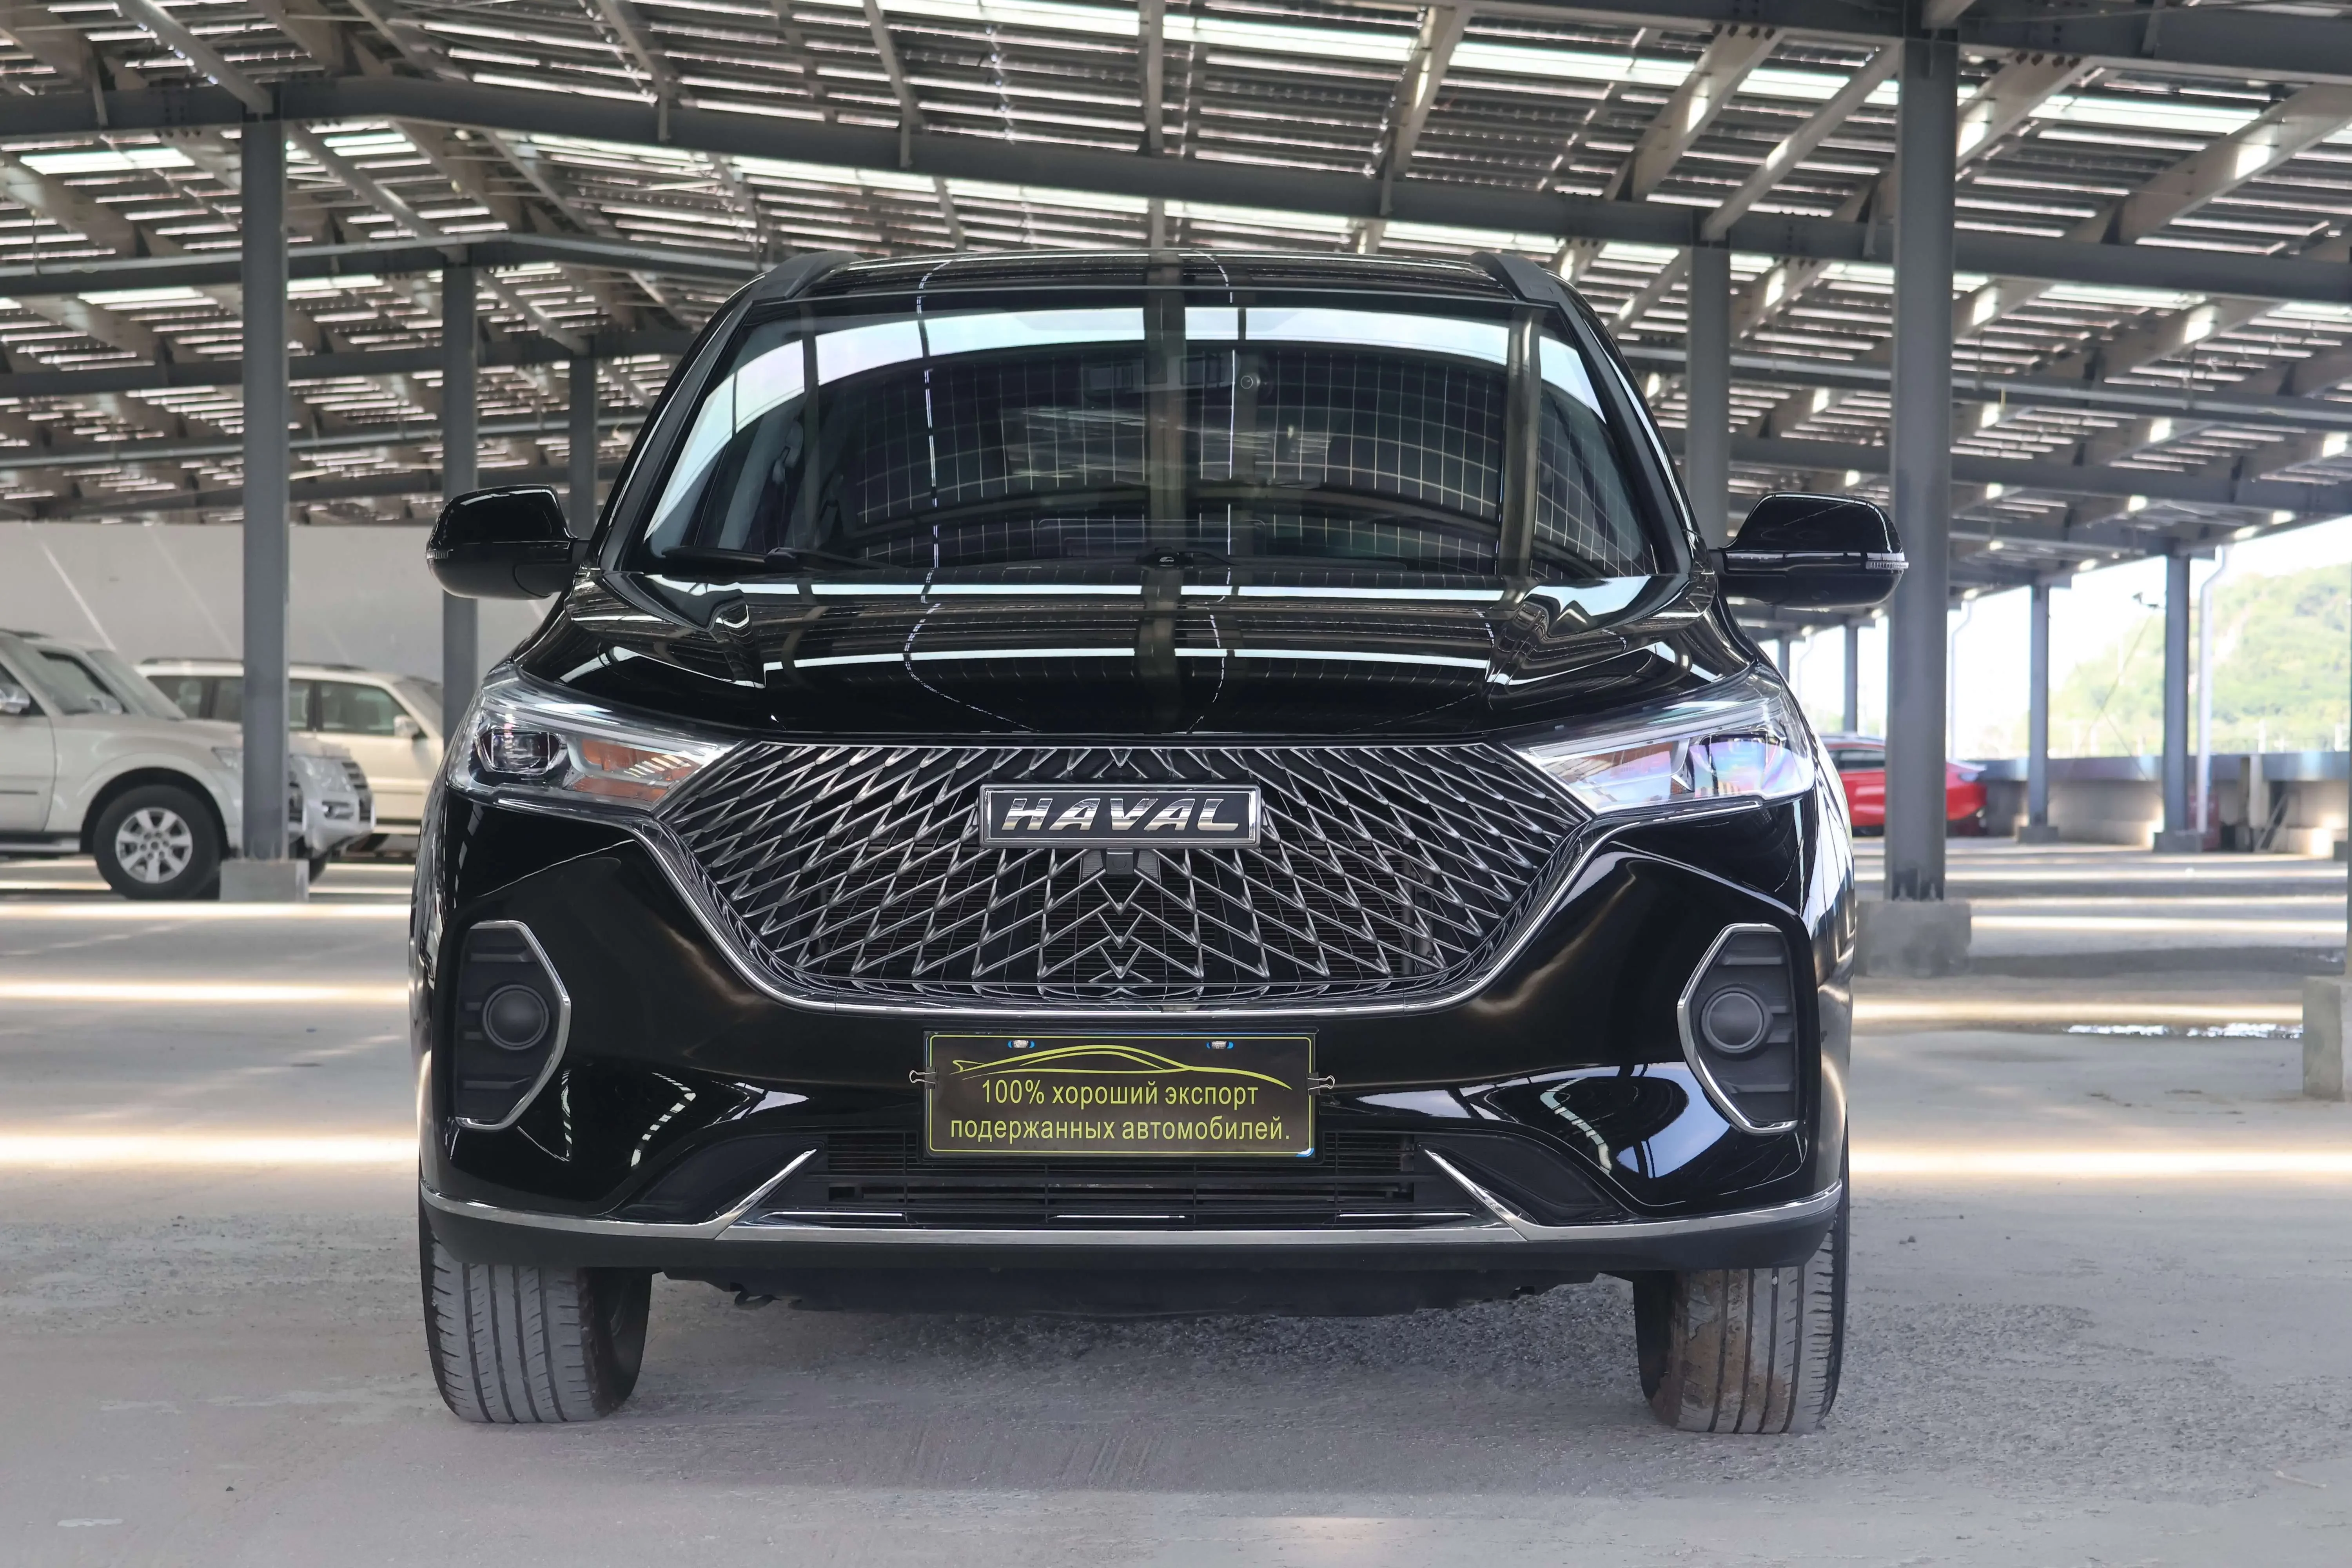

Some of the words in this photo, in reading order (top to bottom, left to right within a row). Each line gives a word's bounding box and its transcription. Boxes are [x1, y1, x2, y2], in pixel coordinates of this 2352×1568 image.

[1001, 798, 1239, 831] HAVAL
[982, 1079, 1045, 1104] 100%
[1052, 1081, 1157, 1110] хороший
[1165, 1086, 1259, 1111] экспорт
[951, 1120, 1115, 1144] подержанных
[1122, 1116, 1290, 1140] автомобилей.
